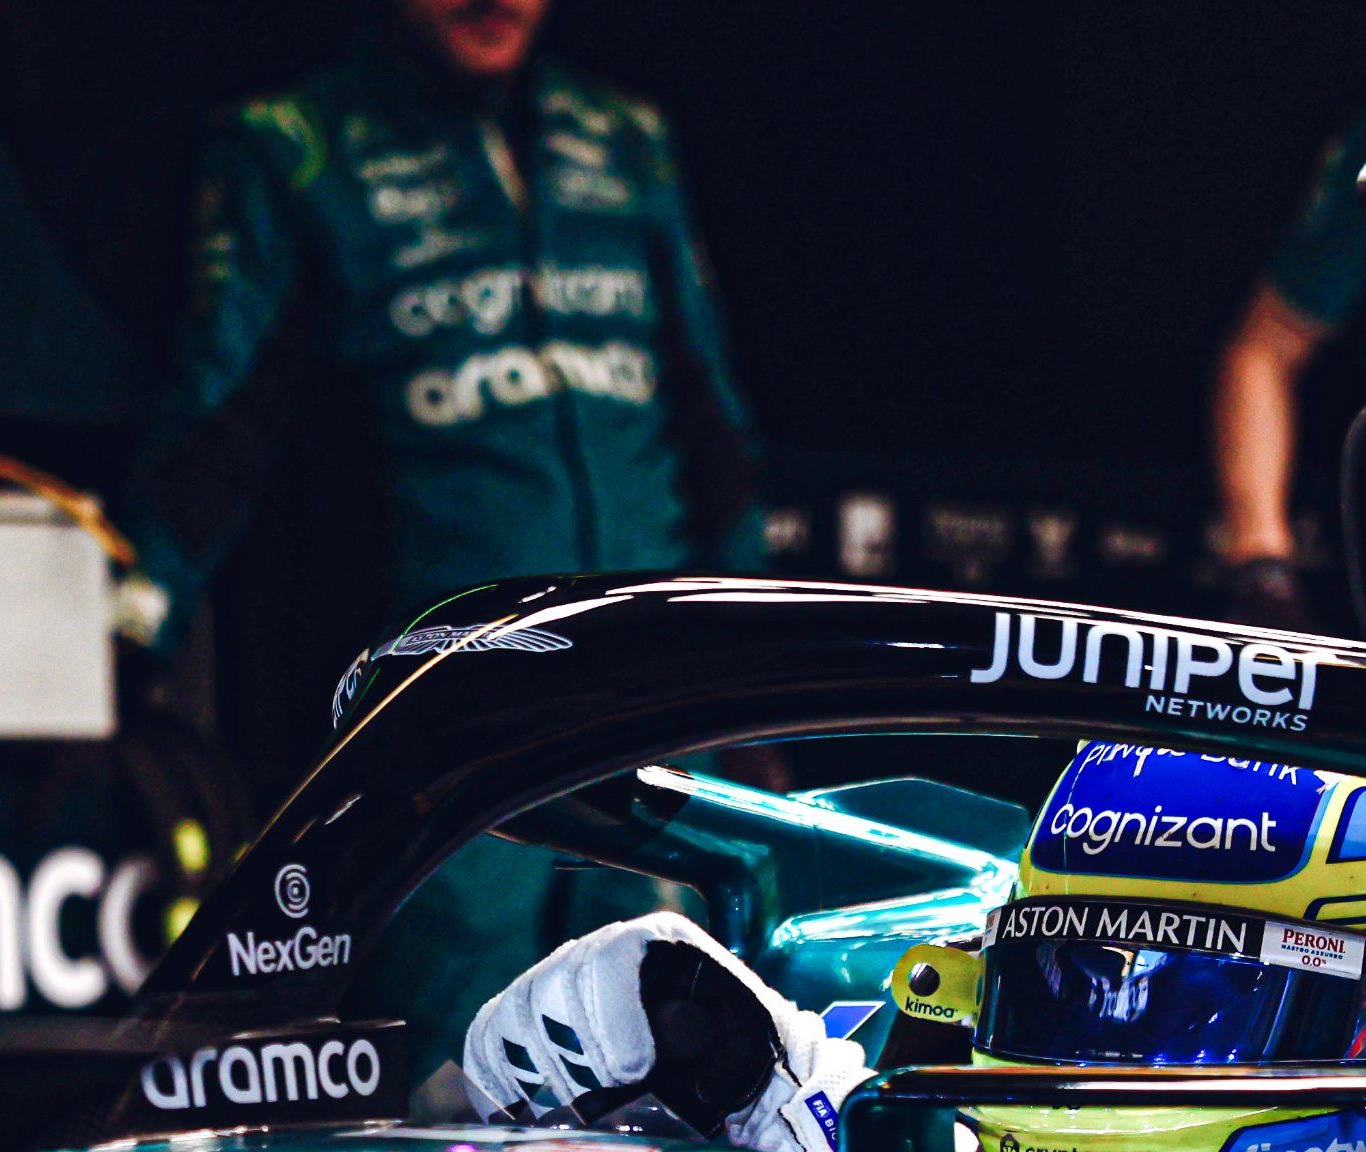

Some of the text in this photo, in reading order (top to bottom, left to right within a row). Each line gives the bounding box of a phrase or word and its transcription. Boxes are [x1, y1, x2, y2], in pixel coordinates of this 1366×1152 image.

[1145, 694, 1310, 732] NETWORKS
[1050, 804, 1277, 856] cognizant
[1002, 906, 1088, 939] ASTON
[1095, 908, 1247, 953] MARTIN
[1281, 944, 1310, 954] NASTRO
[1282, 928, 1346, 954] PERONI
[226, 925, 352, 977] NexGen
[905, 996, 955, 1018] kimoa
[140, 1038, 381, 1111] aramco
